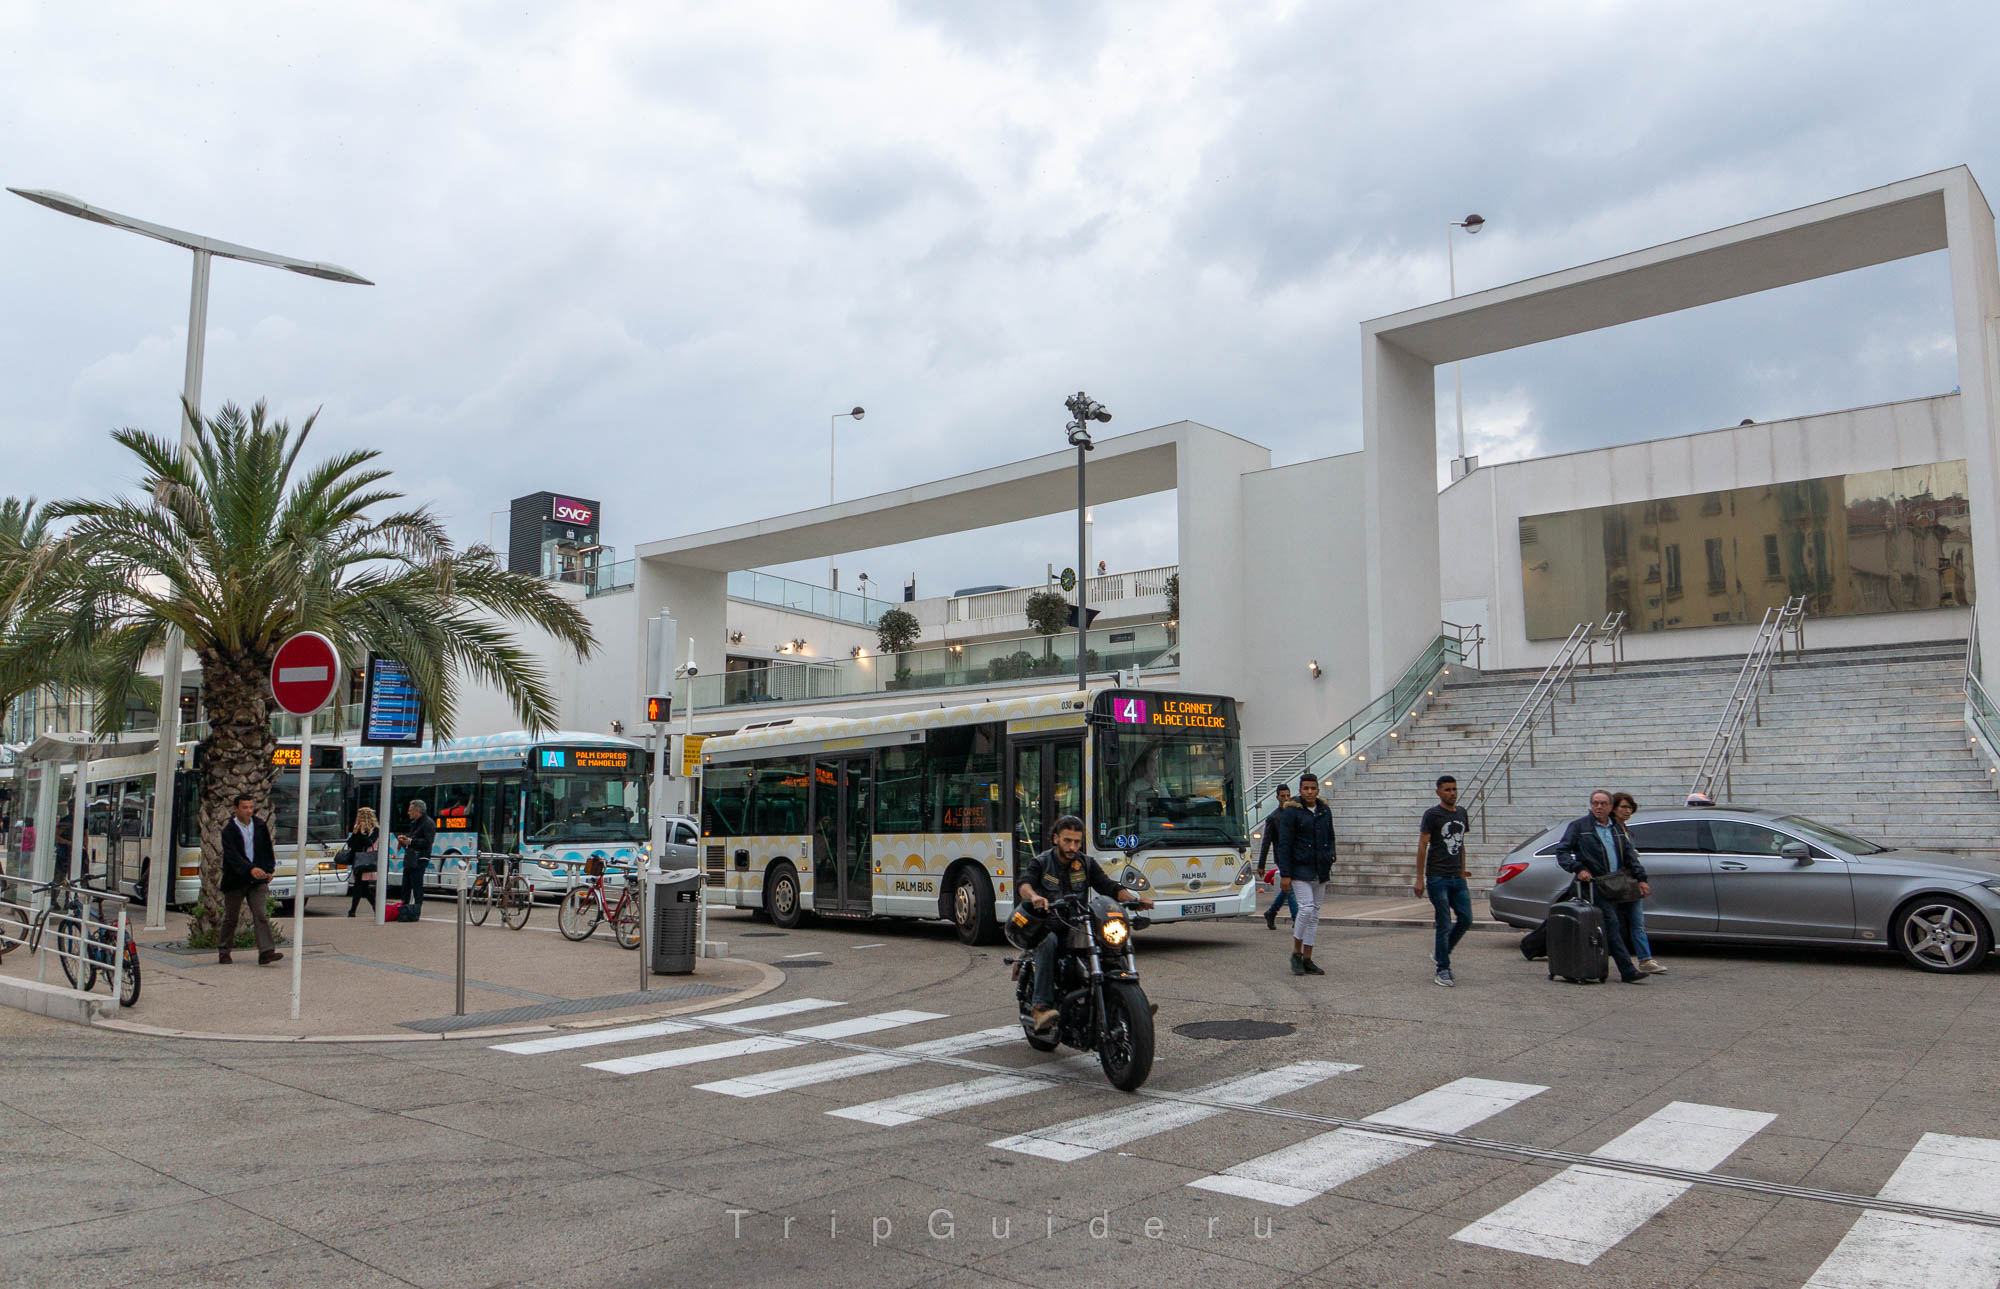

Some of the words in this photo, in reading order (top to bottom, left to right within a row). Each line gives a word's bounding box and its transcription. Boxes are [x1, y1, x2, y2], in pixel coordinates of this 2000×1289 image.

[556, 506, 591, 521] SNCF
[1123, 698, 1138, 723] 4
[1163, 701, 1177, 713] LE
[1179, 702, 1213, 715] CANNET
[1153, 713, 1183, 726] PLACE
[1185, 715, 1225, 728] LECLERC
[69, 735, 85, 743] Quai
[88, 735, 96, 744] M
[273, 749, 302, 758] XPRES
[547, 751, 559, 767] A
[575, 751, 595, 759] PALM
[597, 752, 627, 760] EXPRESS
[577, 759, 587, 767] DE
[588, 759, 626, 767] MANDELIEU
[1224, 857, 1235, 866] 030
[895, 881, 917, 891] PALM
[917, 882, 933, 892] BUS
